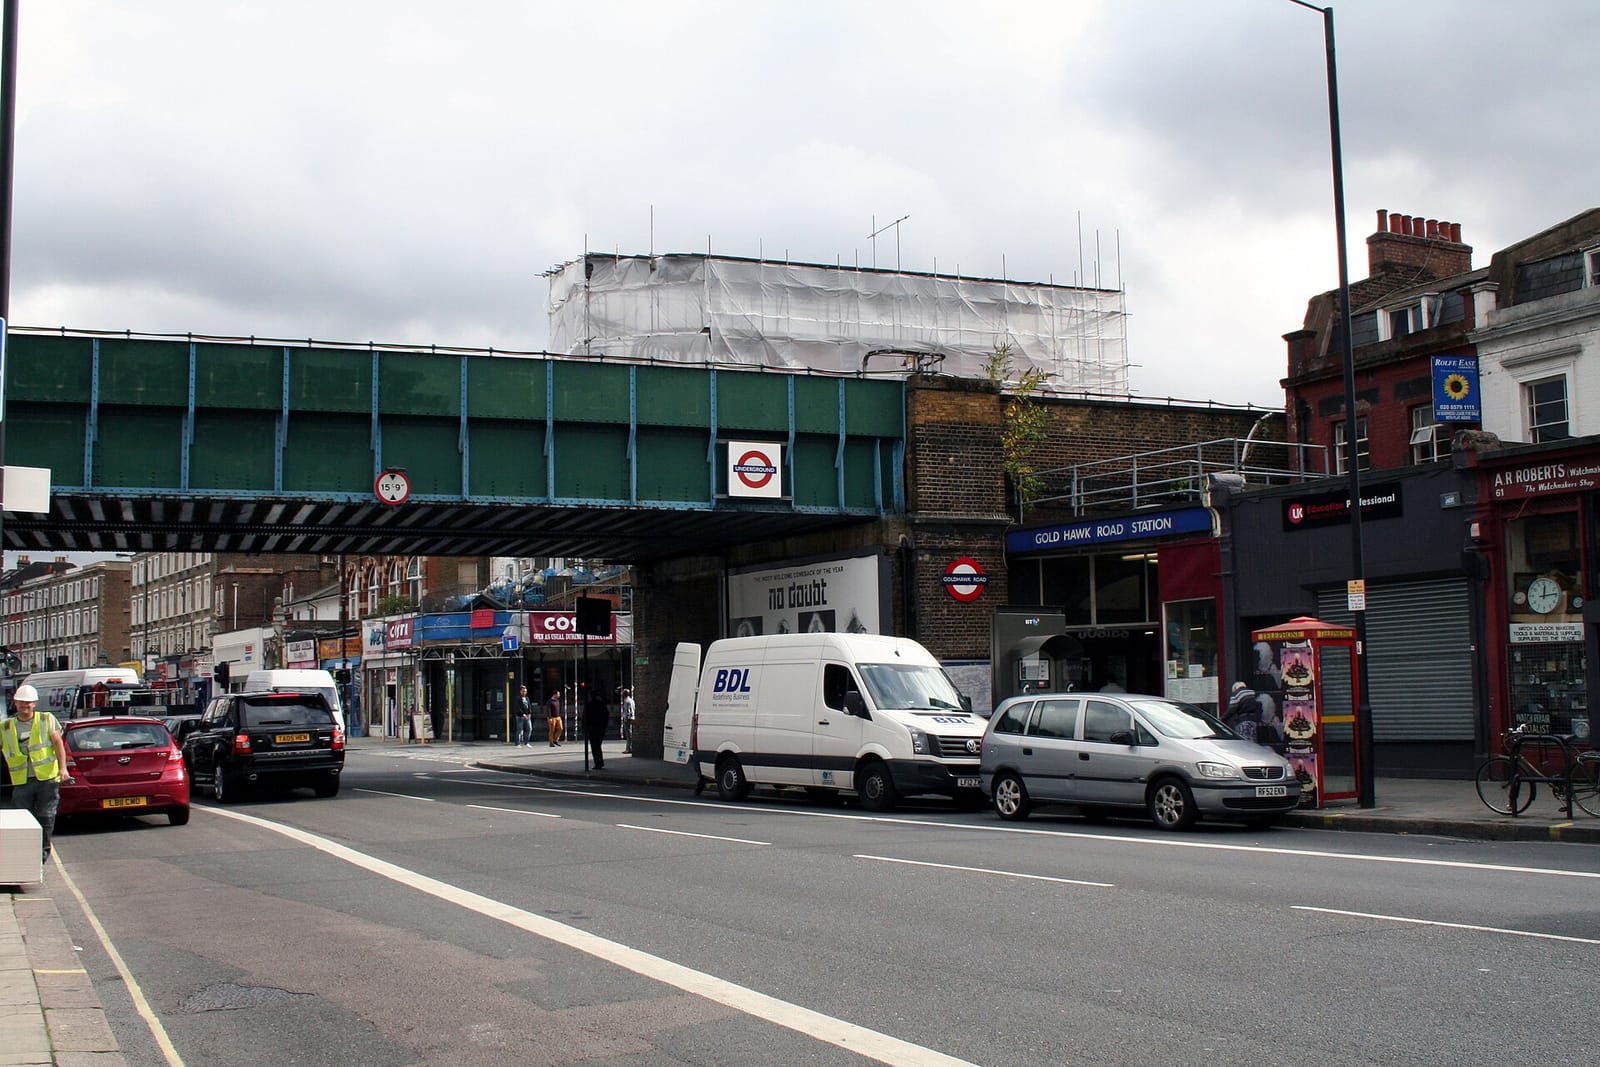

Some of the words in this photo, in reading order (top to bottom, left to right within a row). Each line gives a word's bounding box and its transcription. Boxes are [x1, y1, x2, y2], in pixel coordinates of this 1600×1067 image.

[1516, 464, 1565, 483] ROBERTS
[1495, 488, 1504, 497] 61
[1538, 482, 1577, 491] Watchmakers
[1579, 479, 1594, 487] Shop
[1292, 508, 1303, 519] UK
[1346, 493, 1395, 508] Pfessional
[1035, 531, 1060, 544] GOLD
[1063, 527, 1091, 541] HAWK
[1097, 524, 1123, 537] ROAD
[1131, 517, 1171, 533] STATION
[769, 587, 784, 610] no
[788, 578, 827, 608] doubt
[544, 617, 577, 632] COS
[713, 669, 750, 692] BDL
